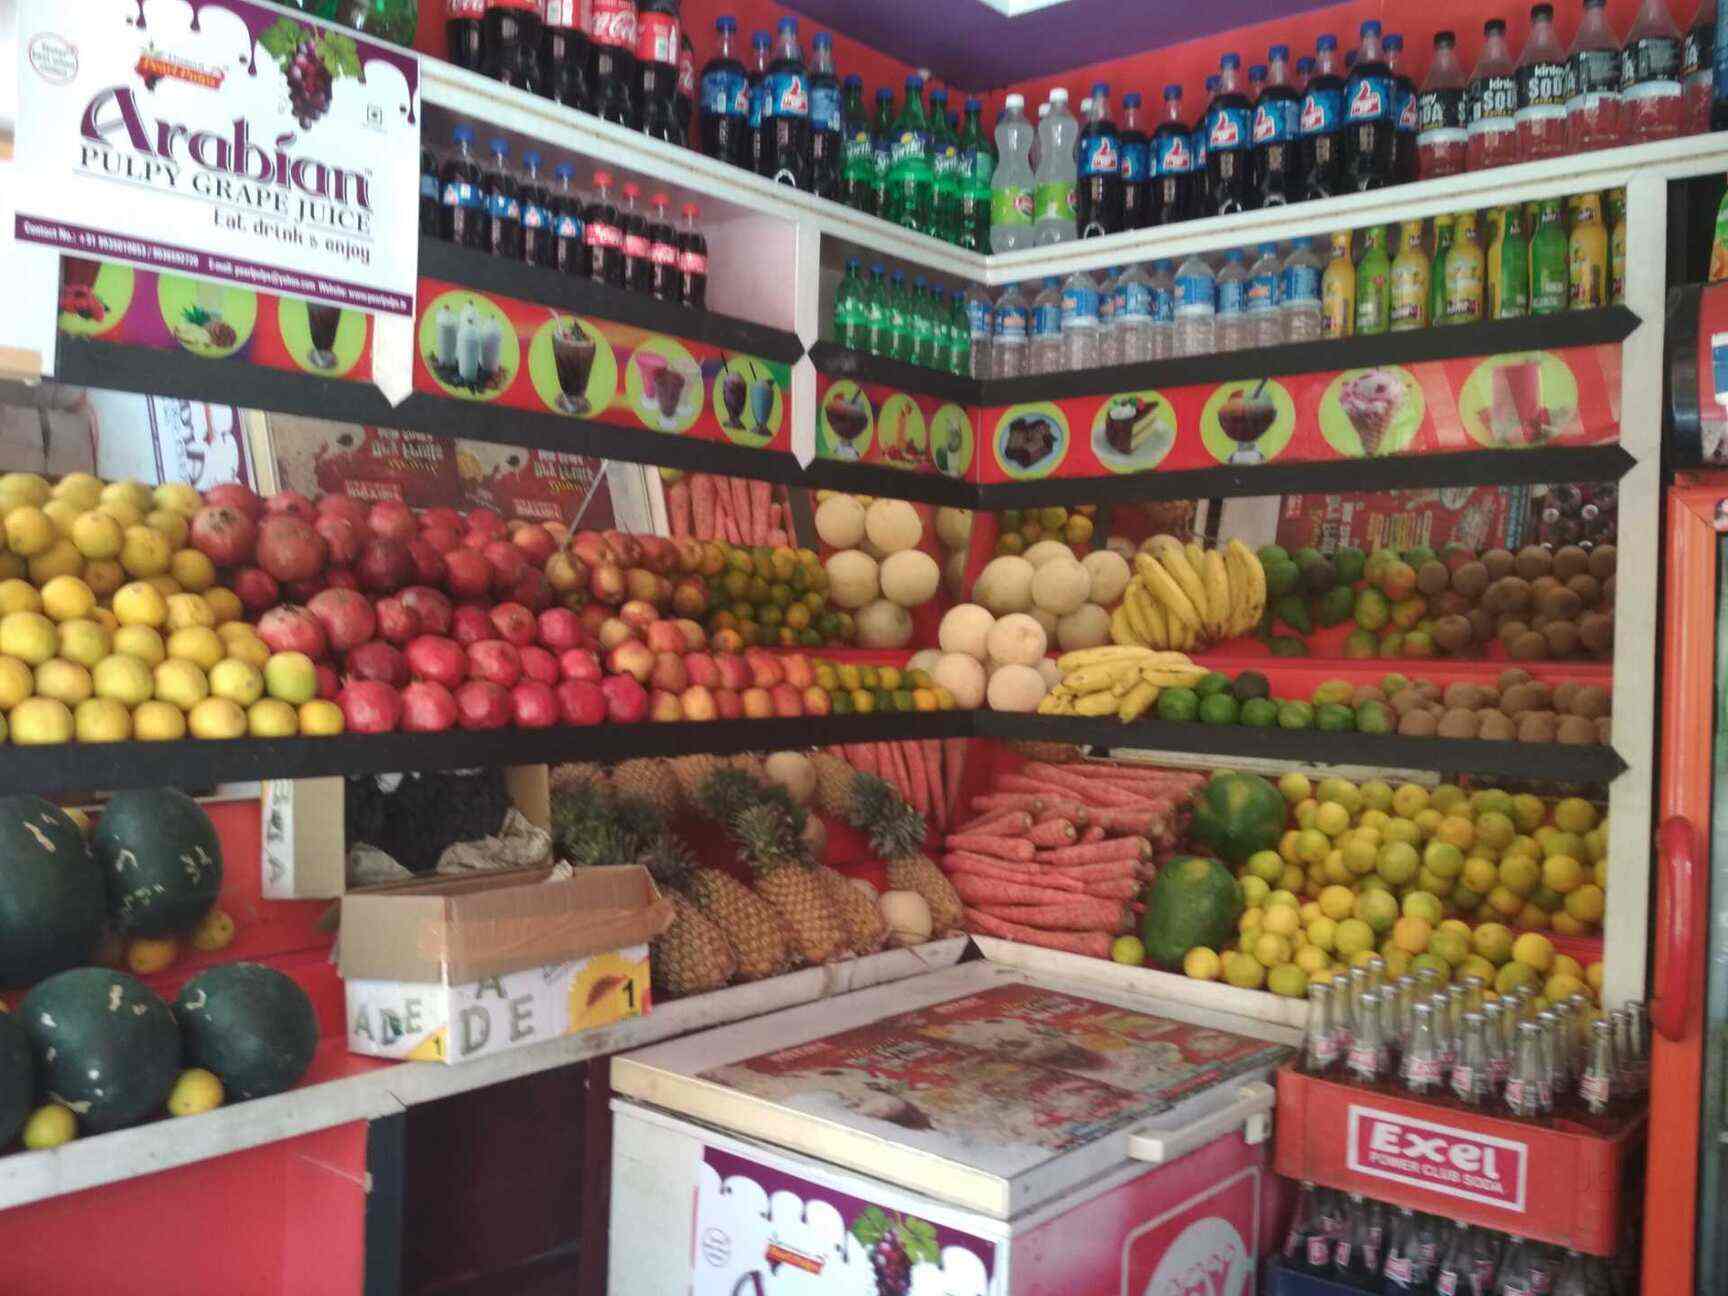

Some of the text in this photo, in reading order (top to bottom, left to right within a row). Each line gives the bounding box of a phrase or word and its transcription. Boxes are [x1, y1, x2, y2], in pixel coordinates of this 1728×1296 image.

[81, 84, 372, 210] Arabian
[80, 144, 372, 234] PULPY GRAPE JUICE
[621, 977, 635, 1009] 1
[1370, 1120, 1500, 1181] Exel
